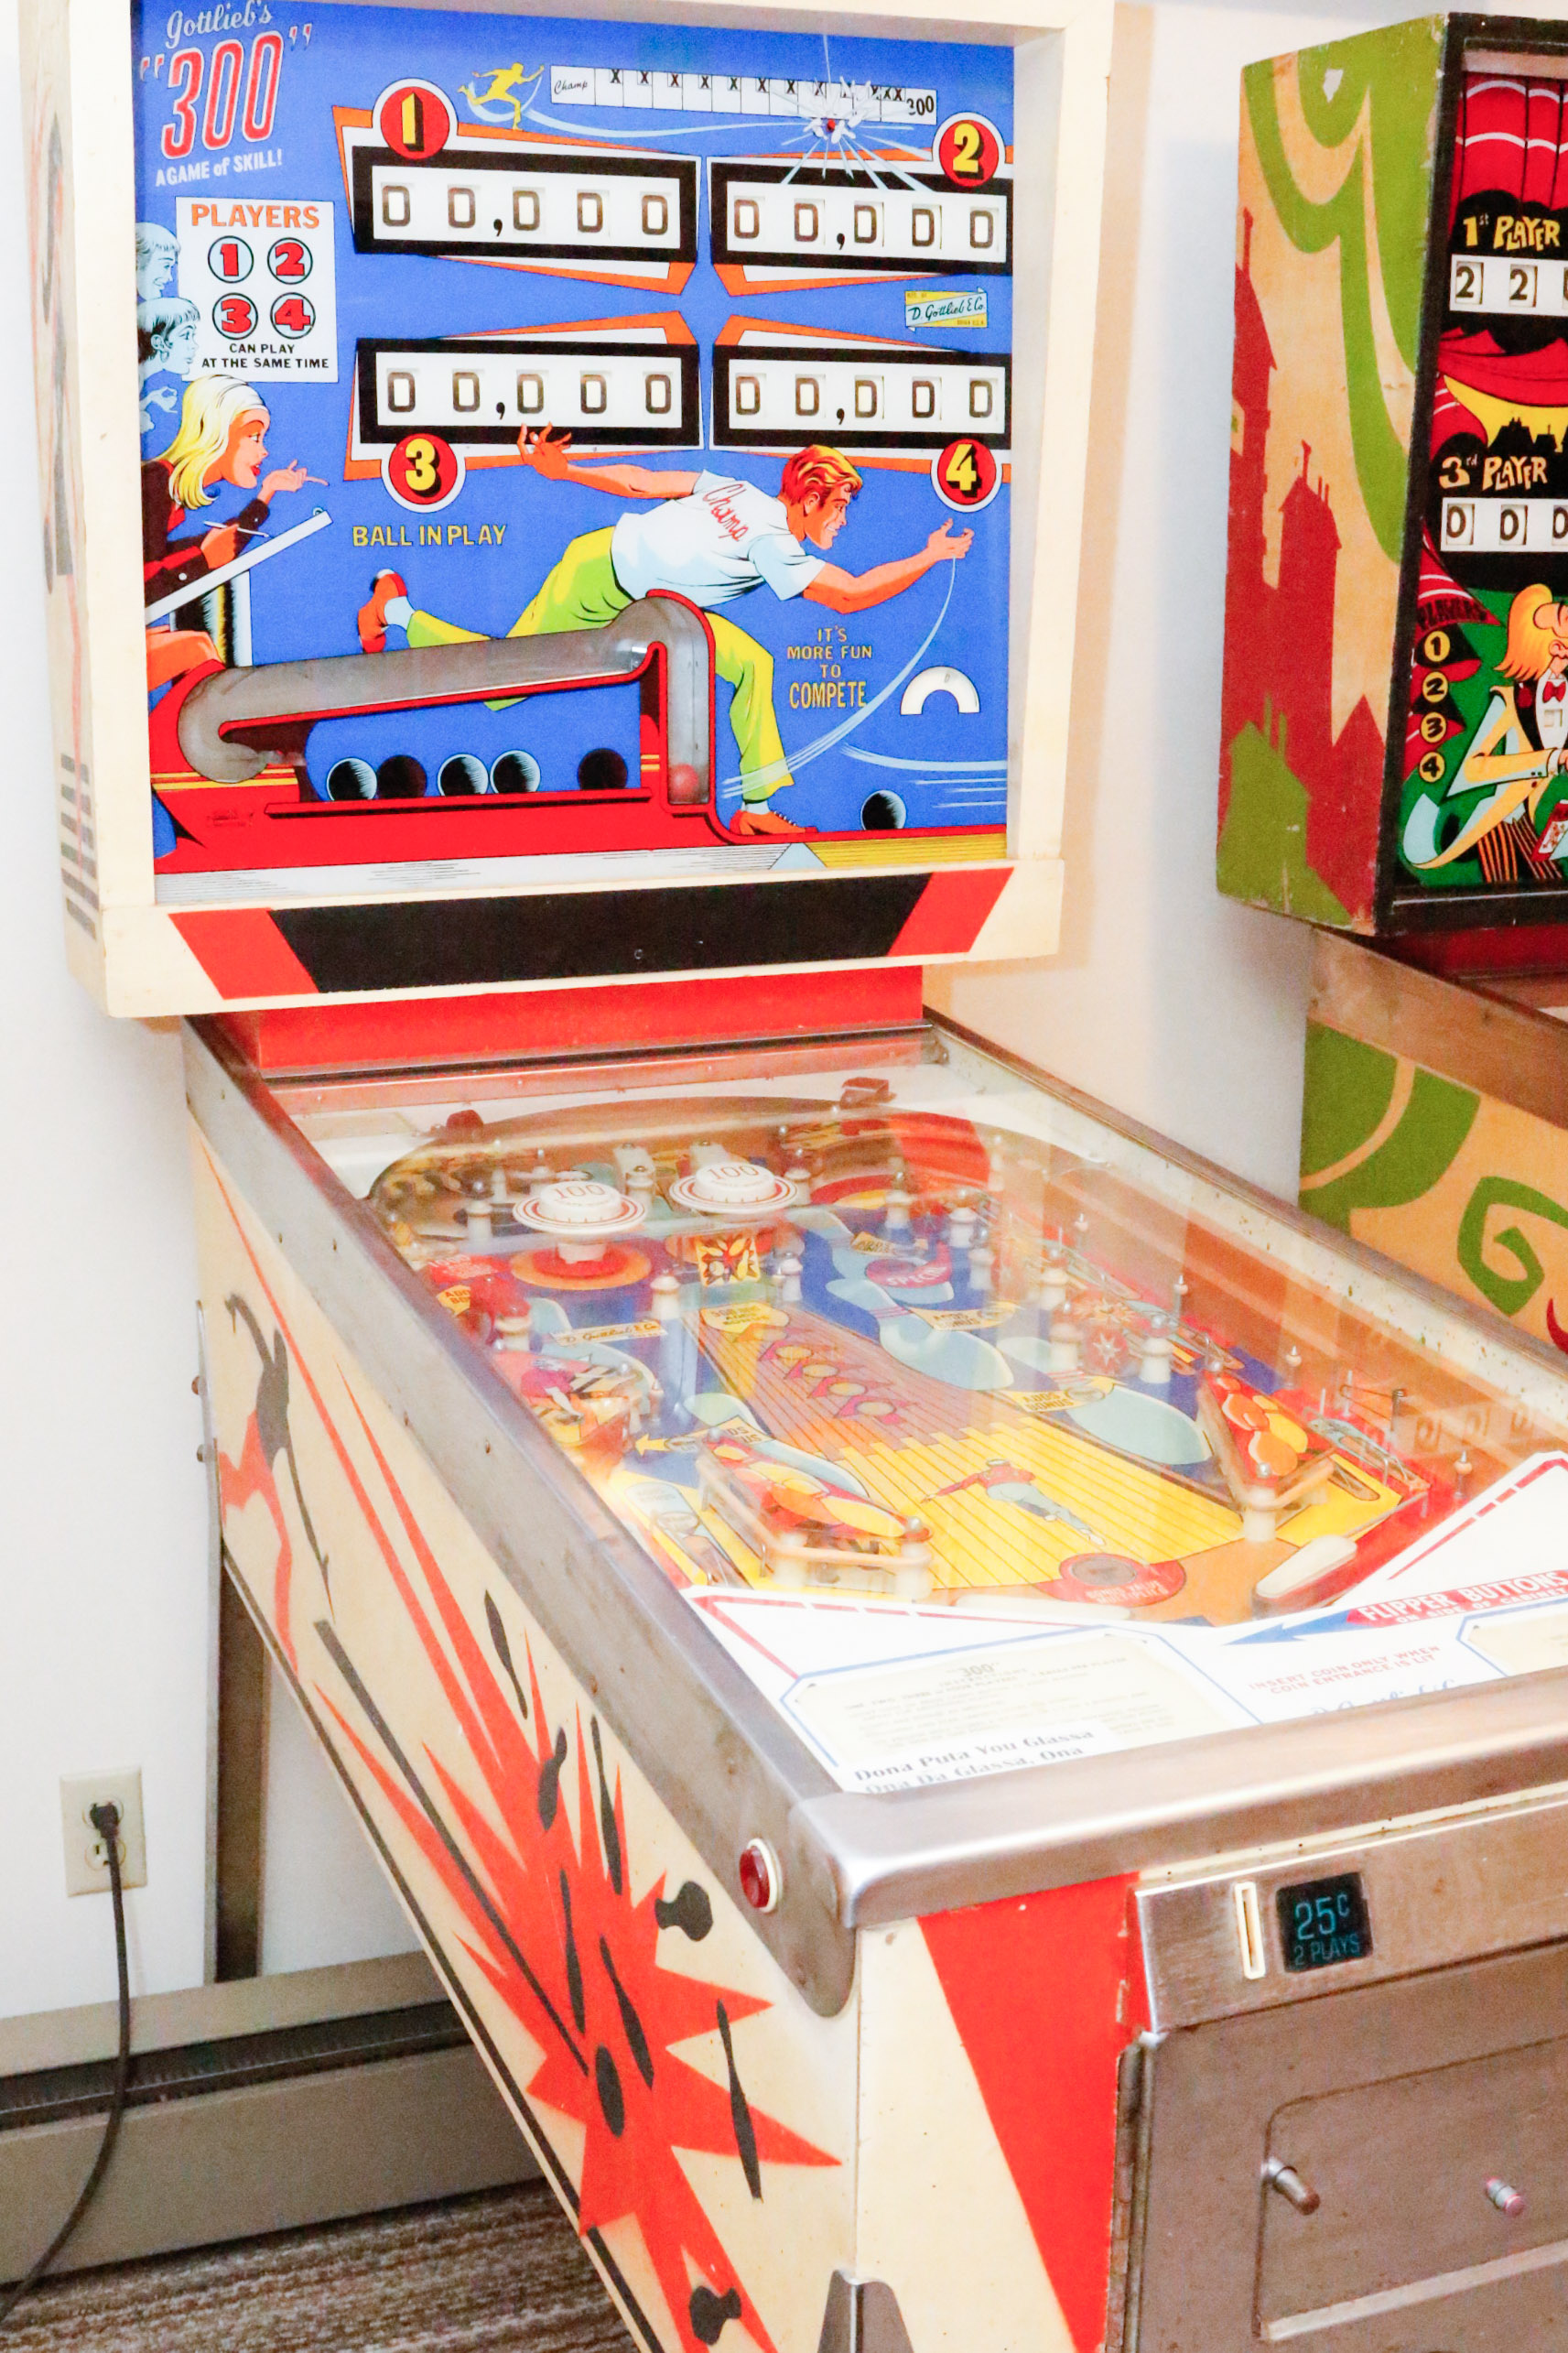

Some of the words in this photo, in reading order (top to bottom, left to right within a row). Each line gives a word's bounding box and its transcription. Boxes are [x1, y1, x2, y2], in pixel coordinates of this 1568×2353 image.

[166, 0, 273, 49] Gottlieb's
[554, 80, 589, 95] Champ
[906, 95, 935, 116] 300
[401, 92, 421, 148] 1
[213, 157, 231, 177] of
[233, 148, 283, 173] SKILL!
[953, 123, 982, 176] 2
[191, 204, 319, 229] PLAYERS
[1493, 214, 1561, 252] PLAYER
[220, 244, 239, 277] 1
[275, 242, 305, 277] 2
[221, 298, 252, 333] 3
[275, 298, 311, 331] 4
[925, 300, 964, 320] Gottlieb
[201, 358, 217, 368] AT
[222, 358, 247, 368] THE
[254, 358, 291, 368] SAME
[296, 358, 330, 368] TIME
[230, 343, 256, 354] CAN
[261, 343, 295, 354] PLAY
[405, 438, 438, 493] 3
[946, 443, 979, 494] 4
[1481, 455, 1548, 491] PLAYER
[702, 483, 752, 542] Champ
[351, 525, 411, 548] BALL
[419, 525, 442, 546] IN
[447, 525, 506, 546] PLAY
[817, 625, 847, 642] IT'S
[1431, 636, 1442, 656] 1
[787, 645, 833, 660] MORE
[840, 645, 872, 659] FUN
[820, 665, 841, 678] TO
[1426, 678, 1445, 696] 2
[789, 681, 867, 710] COMPETE
[1425, 718, 1444, 736] 3
[1422, 760, 1441, 777] 4
[708, 1165, 760, 1180] 100
[554, 1184, 605, 1199] 100
[1357, 1593, 1460, 1621] FLIPPER
[1458, 1571, 1568, 1602] BUTTONS
[1396, 1615, 1421, 1624] ON
[1426, 1608, 1462, 1618] SIDE
[1500, 1588, 1567, 1604] CABINET
[1249, 1673, 1306, 1690] INSERT
[1311, 1664, 1349, 1677] COIN
[1351, 1655, 1389, 1670] ONLY
[1394, 1645, 1441, 1659] WHEN
[1271, 1681, 1311, 1694] COIN
[1313, 1664, 1393, 1686] ENTRANCE
[1395, 1659, 1411, 1668] IS
[1413, 1654, 1436, 1664] LIT
[855, 1762, 914, 1782] Dona
[918, 1750, 970, 1767] Puta
[974, 1740, 1018, 1756] You
[1022, 1730, 1095, 1747] Glassa
[916, 1772, 947, 1785] Da
[1039, 1747, 1084, 1762] Ona
[1293, 1944, 1304, 1966] 2
[1310, 1933, 1360, 1962] PLAYS
